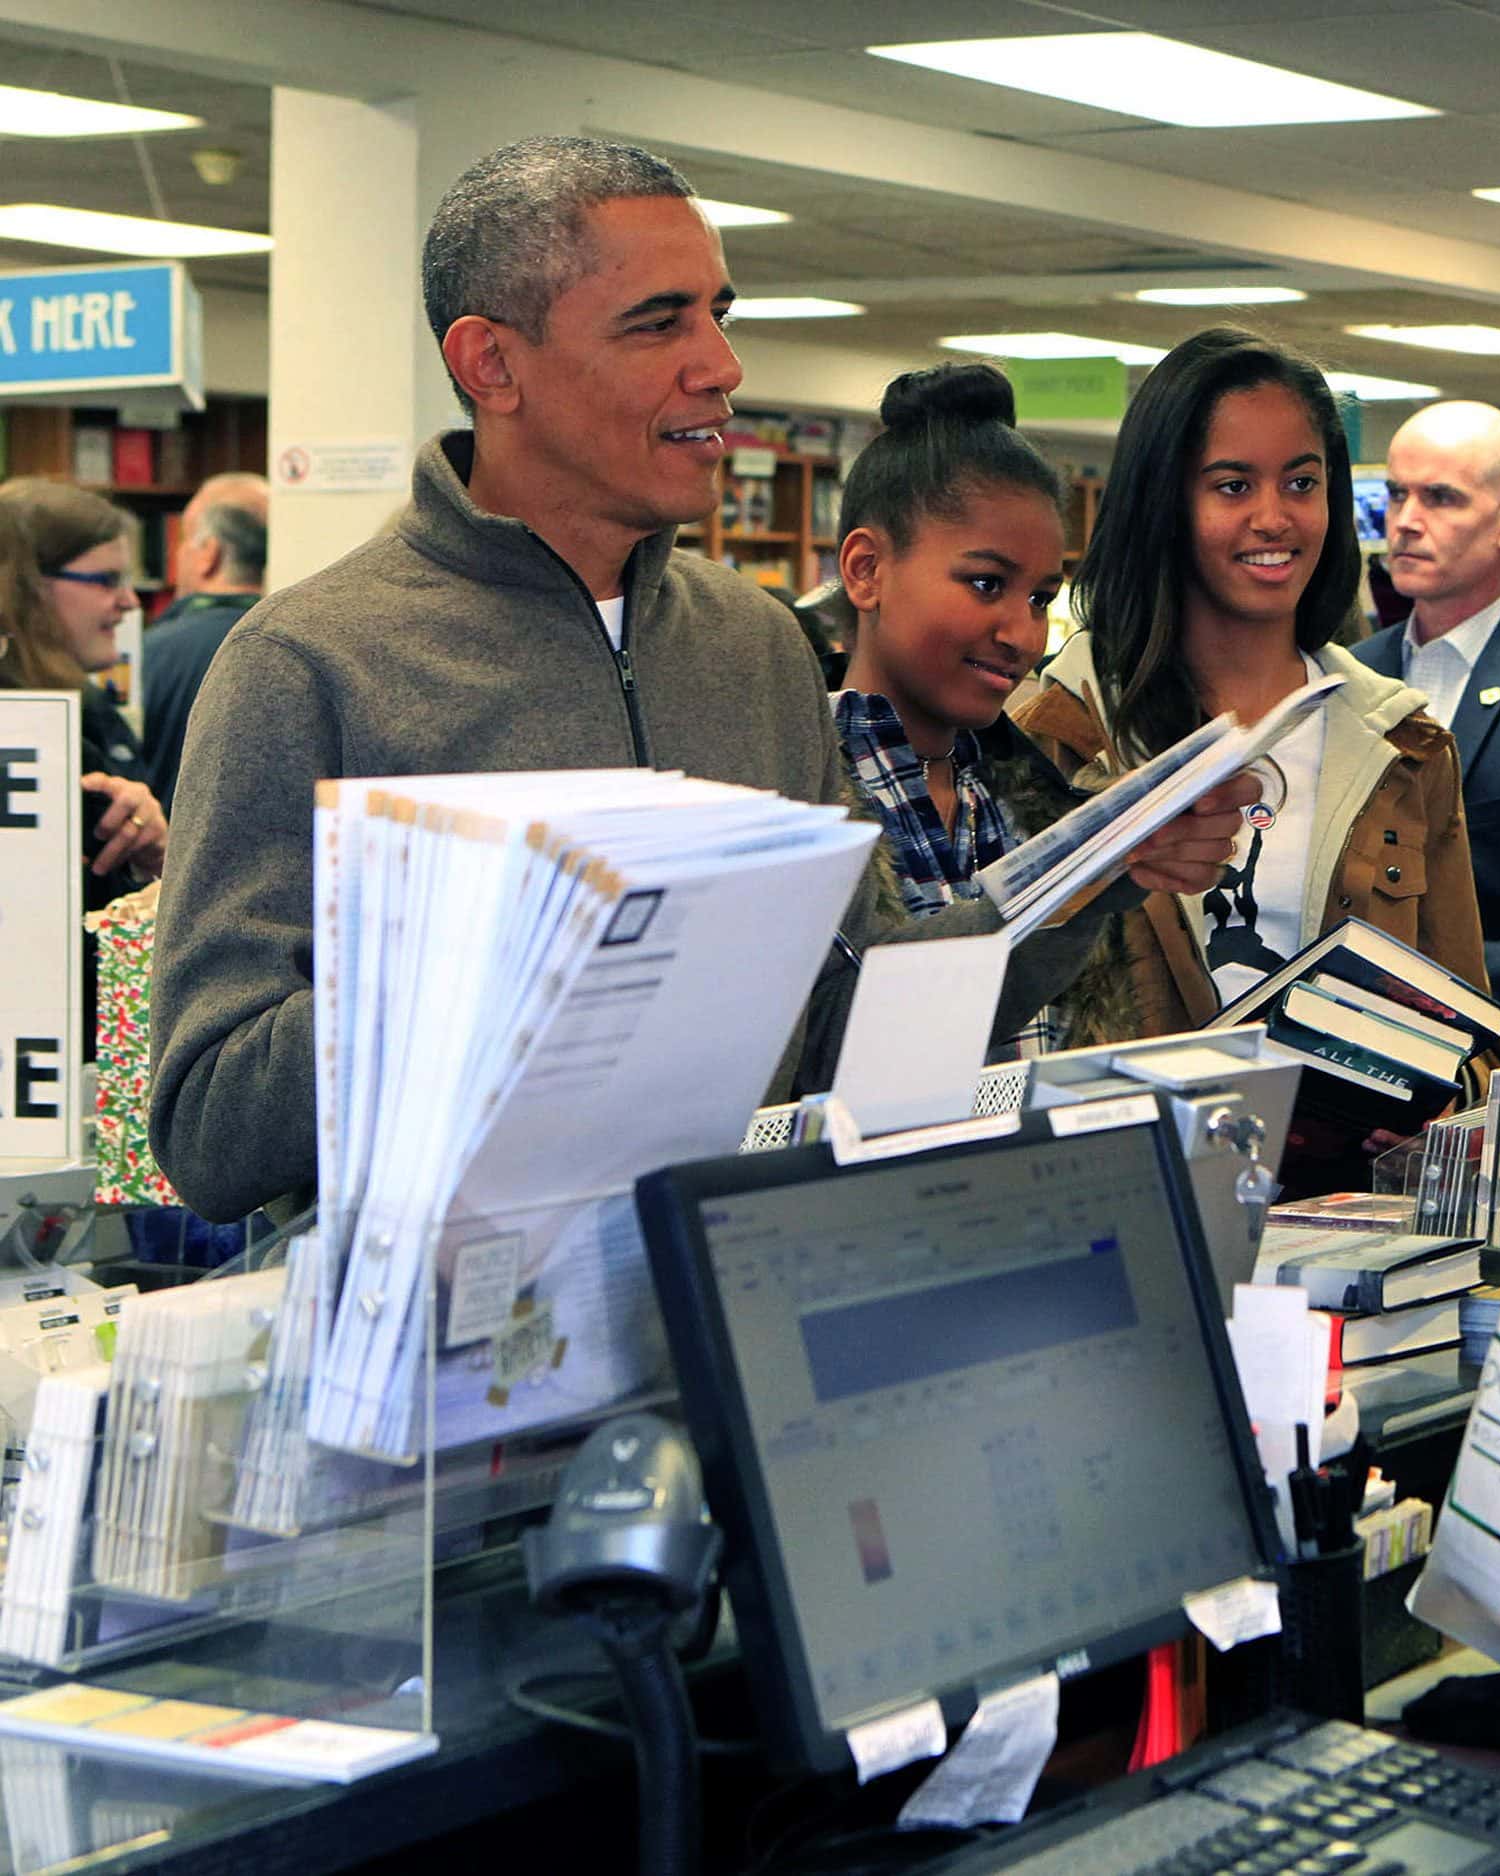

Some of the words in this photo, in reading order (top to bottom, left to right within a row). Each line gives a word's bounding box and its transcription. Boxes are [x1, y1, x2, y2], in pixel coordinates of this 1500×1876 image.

[31, 290, 137, 353] HERE
[1313, 1046, 1354, 1068] ALL
[1366, 1064, 1409, 1088] THE
